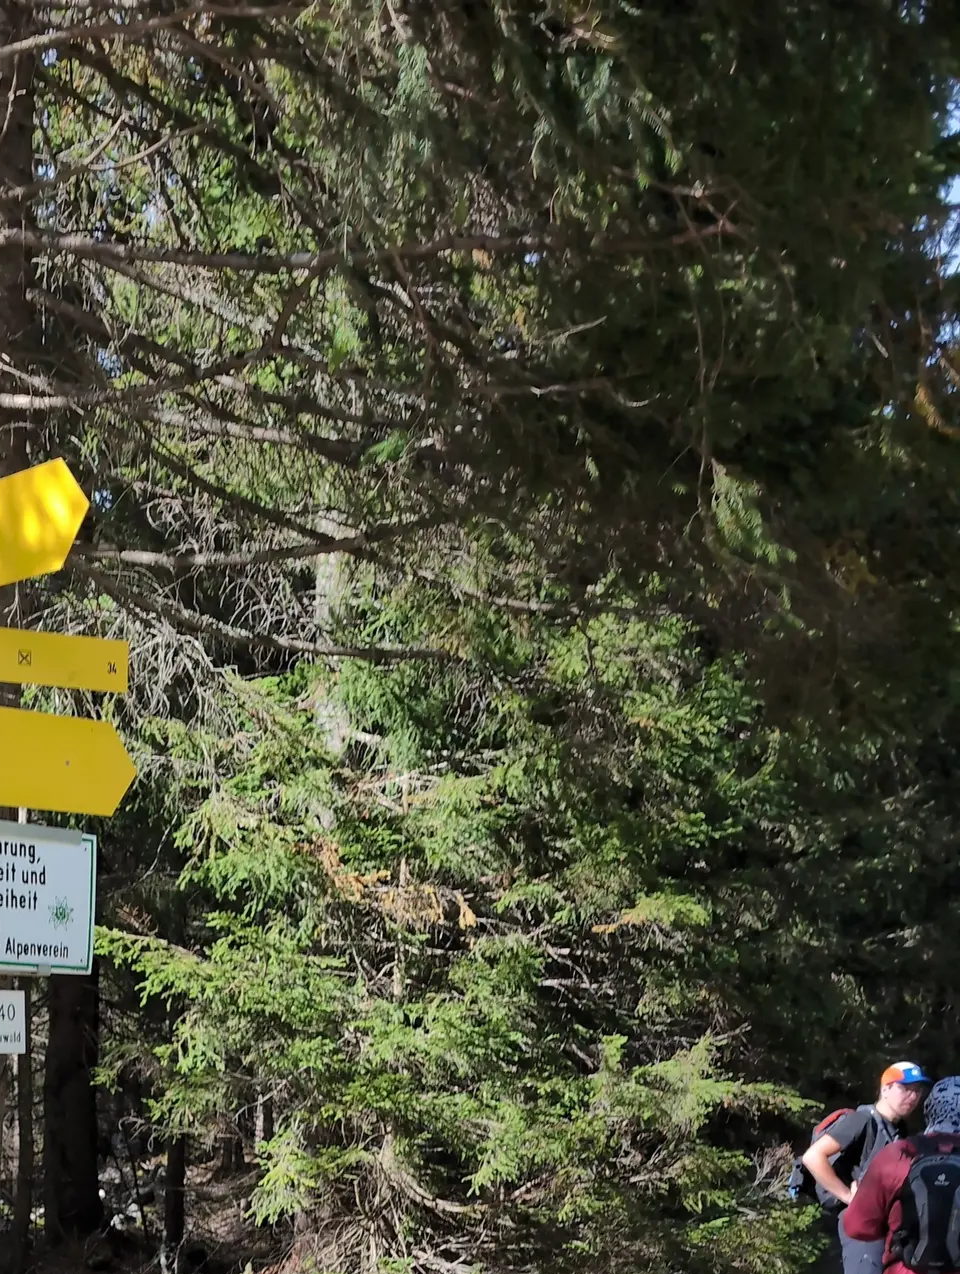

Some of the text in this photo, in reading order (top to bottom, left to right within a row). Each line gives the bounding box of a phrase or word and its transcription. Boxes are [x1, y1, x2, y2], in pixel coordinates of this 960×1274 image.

[107, 661, 117, 675] 34
[22, 865, 46, 885] und
[5, 937, 69, 960] Alpenverein
